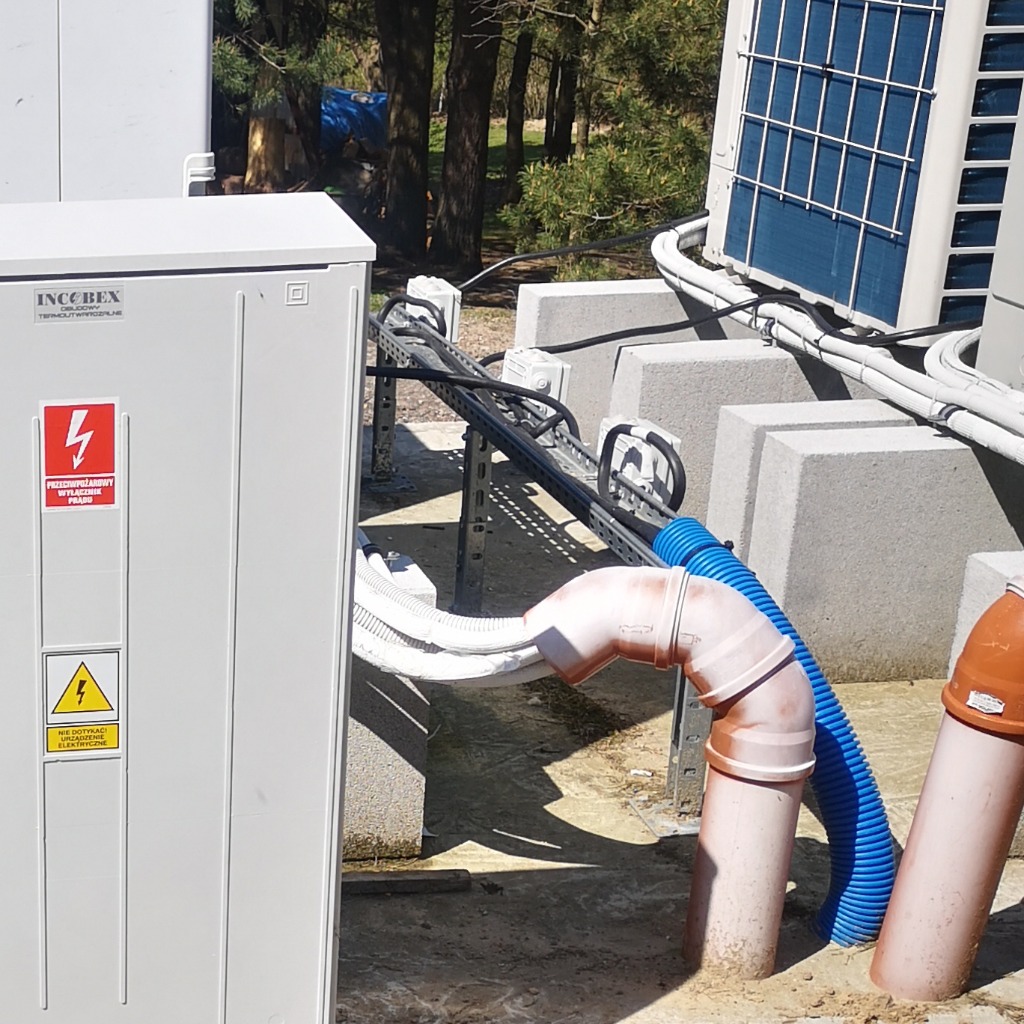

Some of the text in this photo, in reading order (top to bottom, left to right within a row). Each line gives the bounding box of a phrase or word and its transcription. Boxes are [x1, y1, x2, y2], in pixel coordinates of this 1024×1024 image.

[37, 290, 121, 306] INCOBEX
[38, 310, 123, 319] TERMOUTWARDZALNE
[46, 478, 114, 489] PRZECIWPOŻAROWY
[57, 488, 102, 497] WYŁĄCZNIK
[68, 496, 94, 505] PRĄDU
[60, 734, 105, 742] URZĄDZENIE
[57, 740, 108, 749] ELEKTRYCZNE
